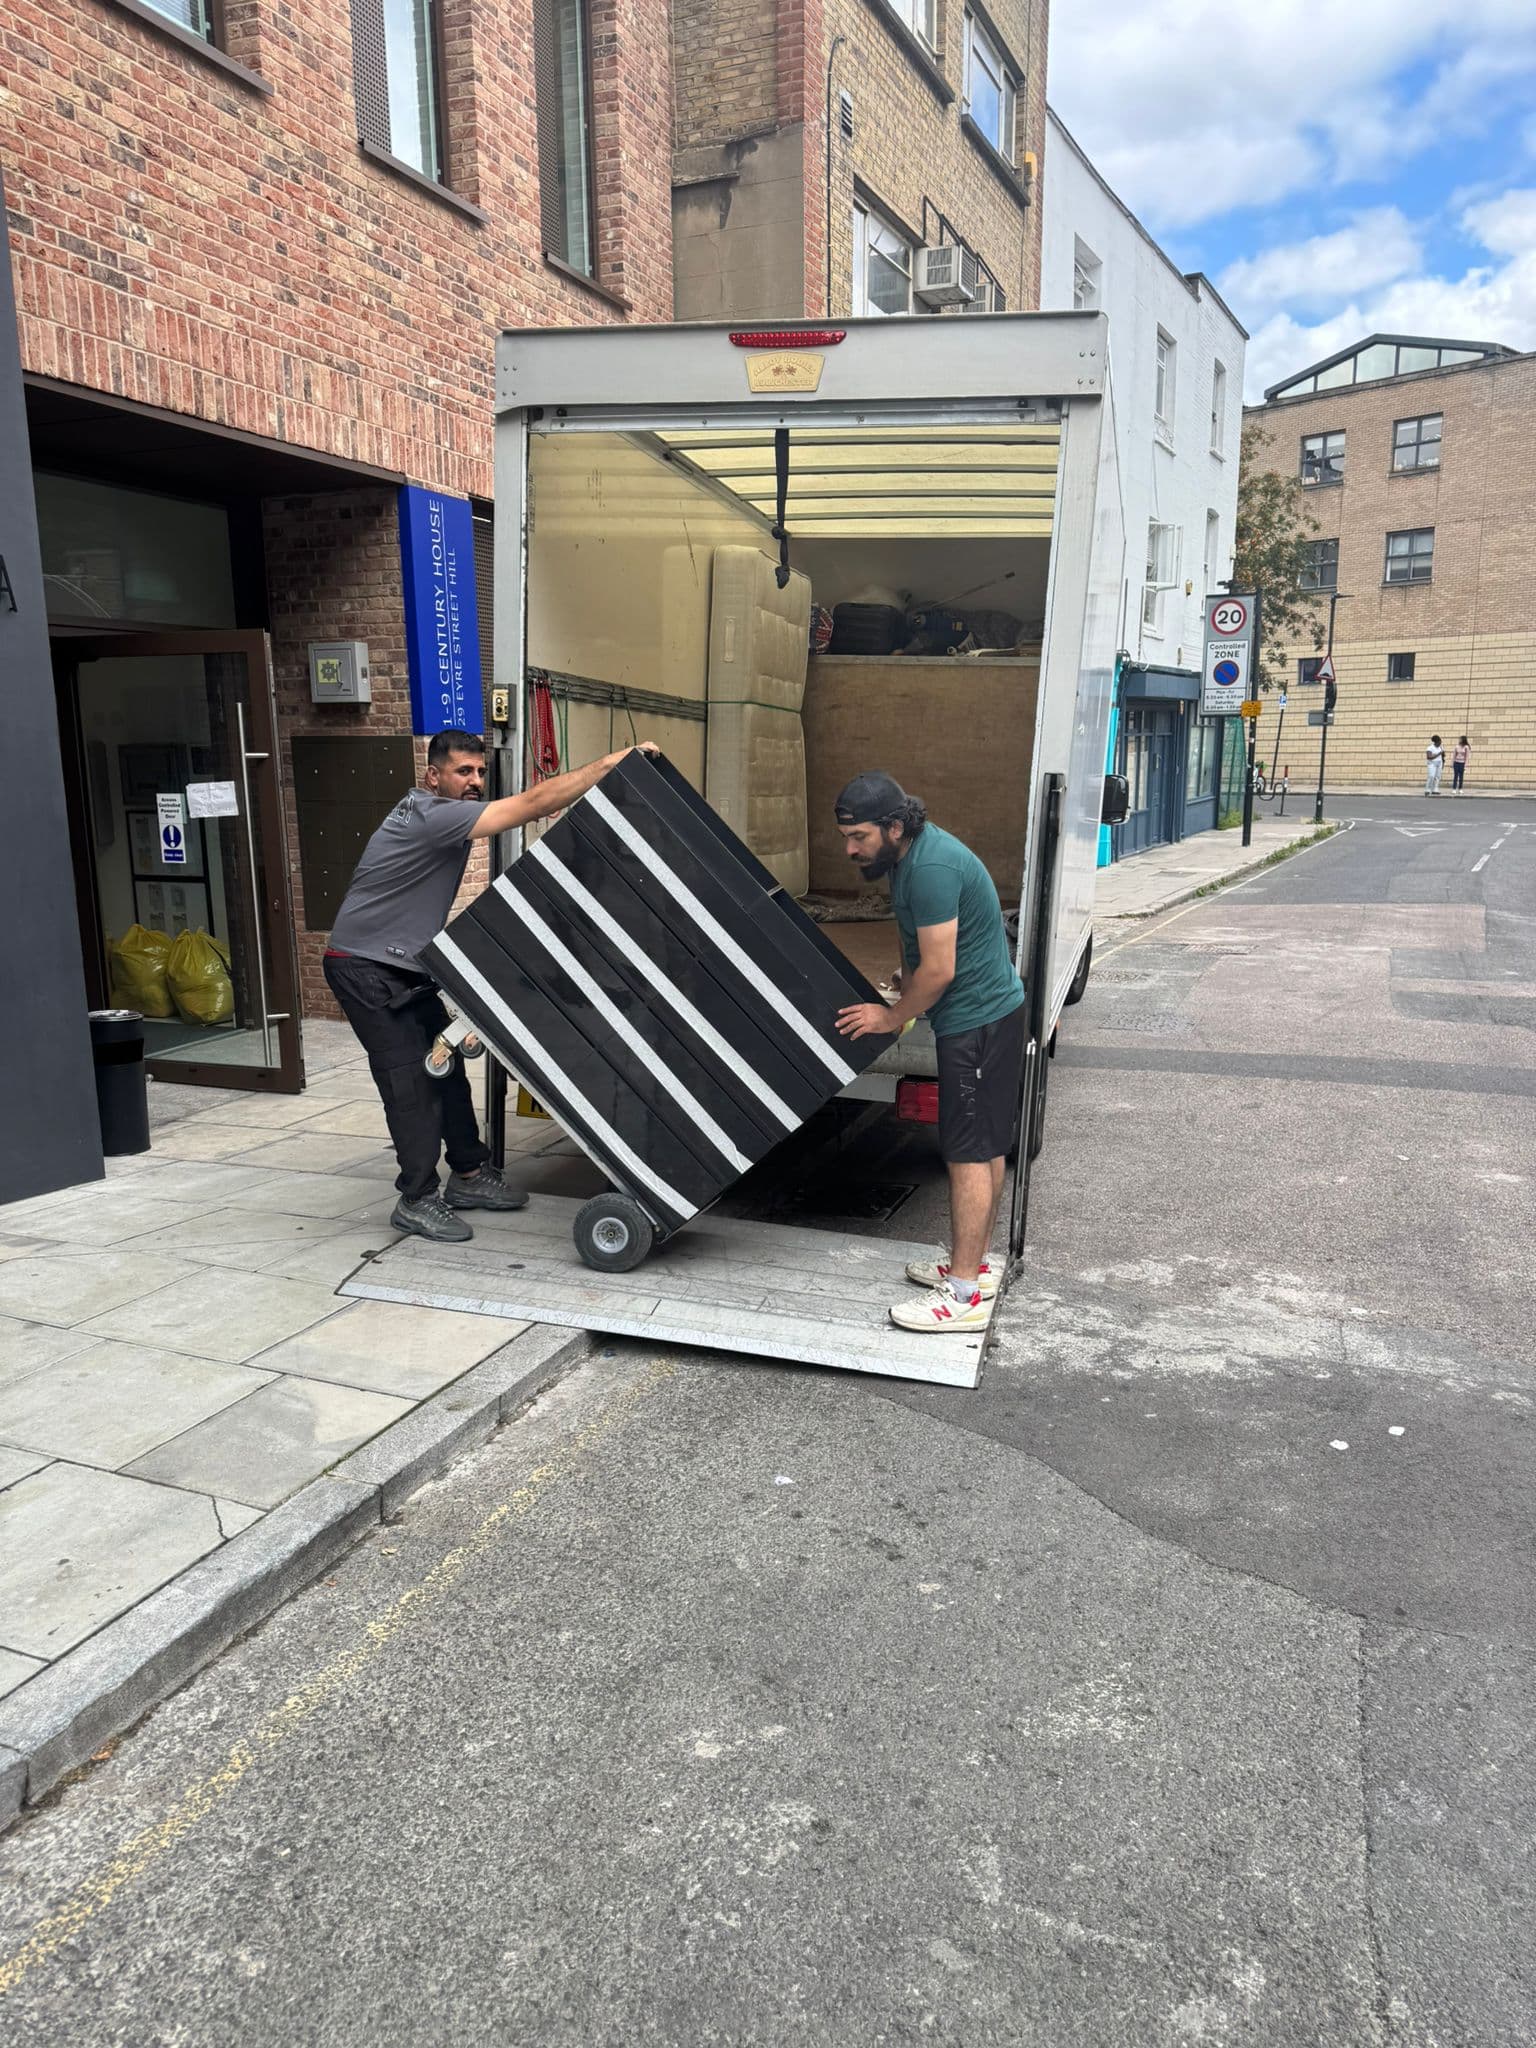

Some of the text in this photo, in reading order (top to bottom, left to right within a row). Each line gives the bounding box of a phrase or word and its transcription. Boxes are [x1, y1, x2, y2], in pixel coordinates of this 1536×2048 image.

[429, 498, 453, 726] 1-9 CENTURY HOUSE
[1218, 610, 1242, 624] 20
[448, 547, 464, 727] 29 EYRE STREET HILL
[1209, 642, 1246, 650] Controlled
[1214, 650, 1240, 659] ZONE
[931, 1304, 953, 1321] N
